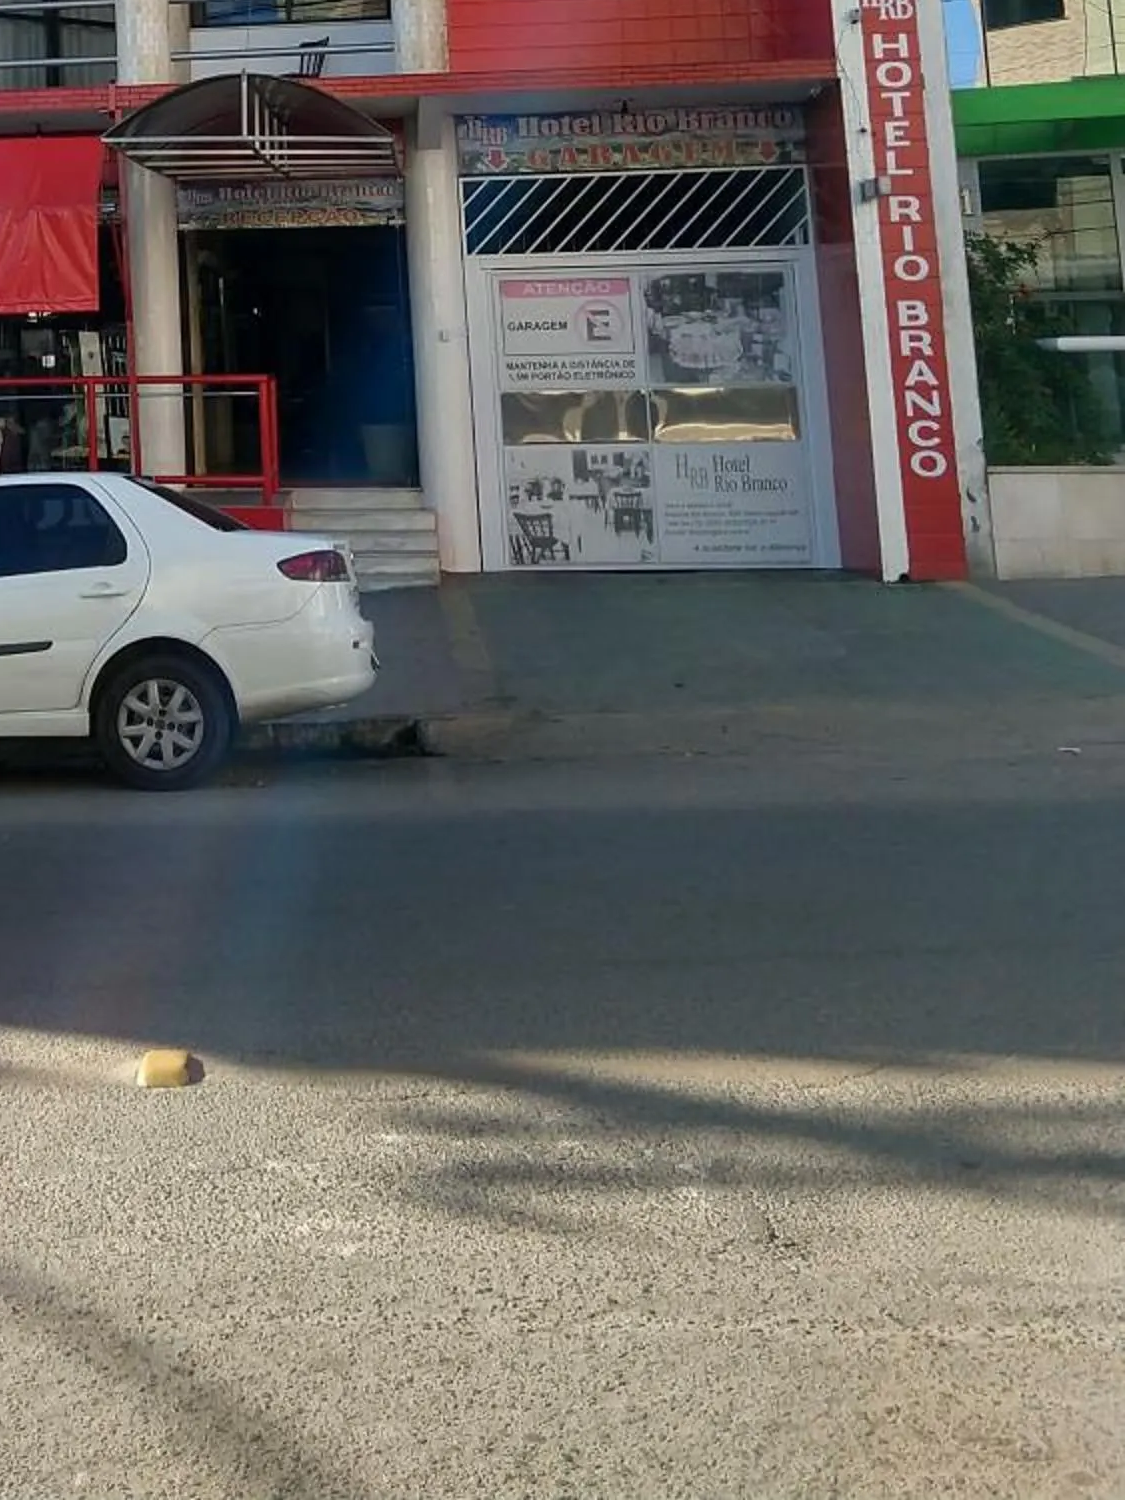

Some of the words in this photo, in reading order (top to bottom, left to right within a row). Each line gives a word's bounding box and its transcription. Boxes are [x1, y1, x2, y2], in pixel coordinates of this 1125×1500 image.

[872, 33, 913, 176] HOTEL
[517, 115, 602, 137] Hotel
[888, 195, 930, 282] RIO
[522, 279, 611, 296] ATENÇÃO
[507, 321, 568, 332] GARAGEM
[896, 299, 948, 478] BRANCO
[712, 453, 750, 473] Hotel
[714, 474, 738, 493] Rio
[741, 474, 788, 493] Branco
